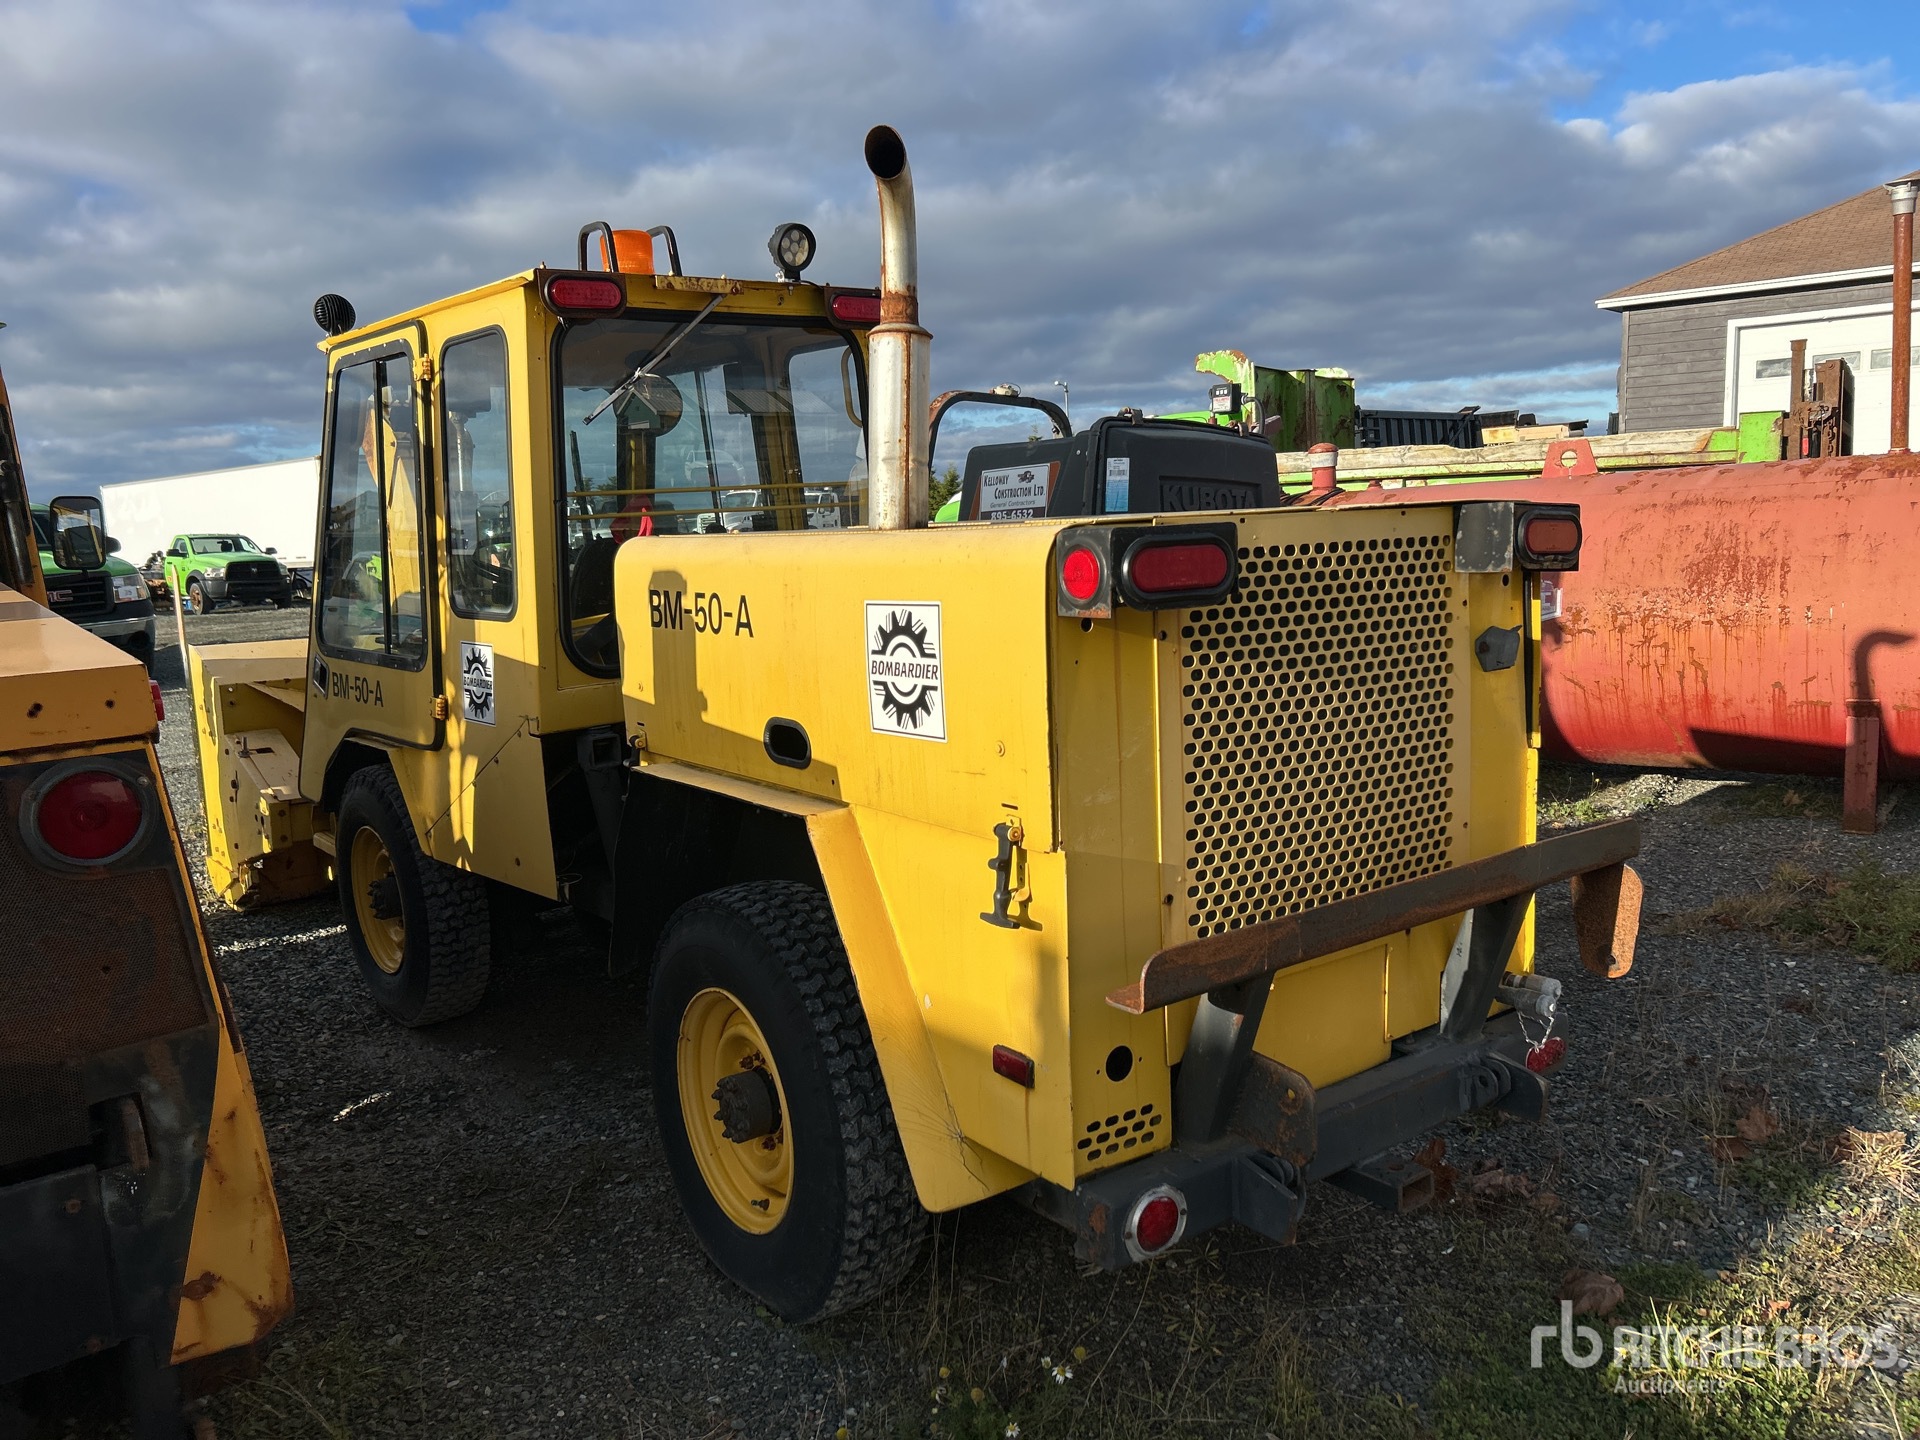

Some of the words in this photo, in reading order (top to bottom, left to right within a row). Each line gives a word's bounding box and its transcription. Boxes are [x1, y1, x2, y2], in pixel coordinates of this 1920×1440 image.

[994, 487, 1032, 499] CONSTRUCTION
[1161, 484, 1257, 511] KUBOTA
[991, 509, 1034, 520] 895-6532
[649, 588, 754, 638] BM-50-A
[871, 660, 939, 680] BOMBARDIER
[331, 671, 384, 707] BM-50-A
[463, 676, 493, 690] BOMBARDIER
